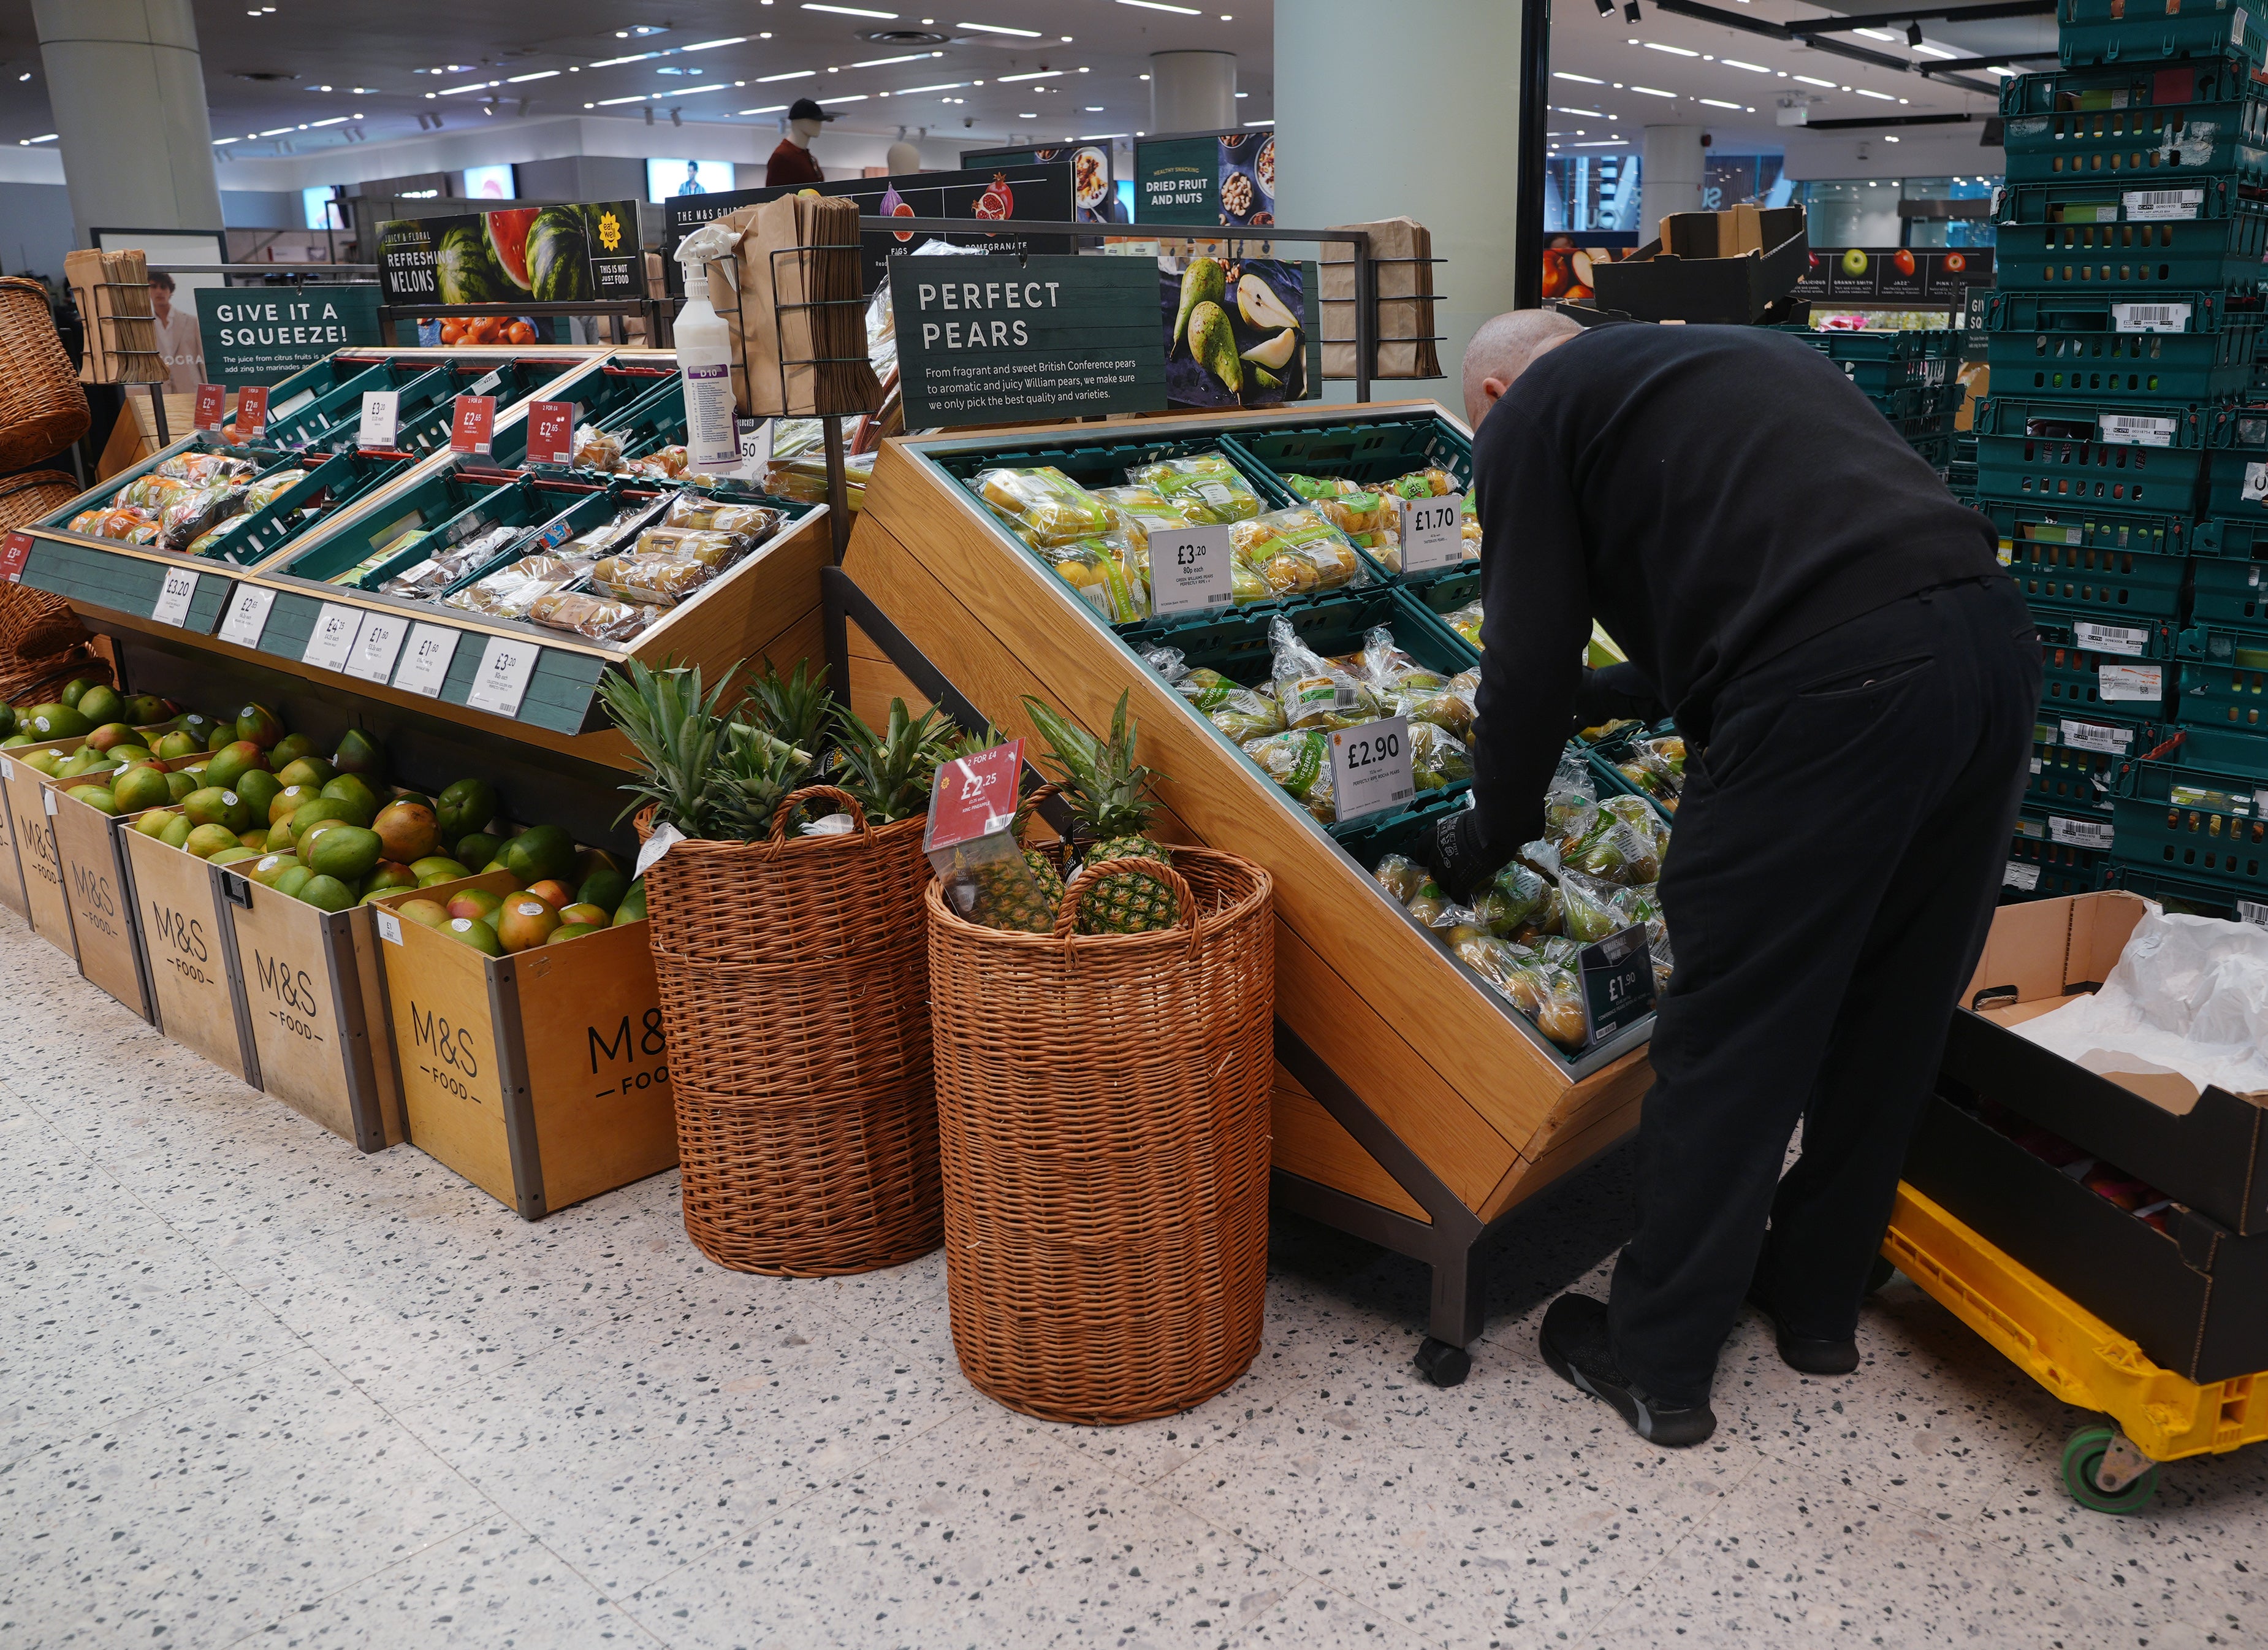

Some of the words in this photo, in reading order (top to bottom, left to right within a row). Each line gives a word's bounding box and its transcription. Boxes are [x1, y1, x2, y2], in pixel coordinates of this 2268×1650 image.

[1153, 167, 1174, 176] HEALTHY
[1146, 180, 1176, 193] DRIED
[1178, 178, 1208, 191] FRUIT
[1151, 194, 1173, 205] AND
[1175, 192, 1203, 204] NUTS
[677, 212, 693, 221] THE
[696, 210, 714, 220] M&S
[603, 223, 613, 231] eat
[604, 227, 617, 239] well
[385, 234, 401, 243] JUICY
[409, 231, 431, 241] FLORAL
[387, 250, 453, 267] REFRESHING
[599, 264, 611, 274] THIS
[612, 264, 617, 273] IS
[618, 264, 628, 273] NOT
[390, 269, 435, 294] MELONS
[614, 274, 630, 285] FOOD
[919, 281, 1060, 311] PERFECT
[217, 304, 278, 322] GIVE
[289, 304, 310, 320] IT
[322, 303, 338, 319] A
[220, 326, 348, 346] SQUEEZE!
[923, 319, 1029, 351] PEARS
[238, 355, 254, 364] juice
[240, 365, 254, 374] zing
[700, 369, 718, 378] D10
[926, 367, 951, 379] From
[953, 365, 991, 380] fragrant
[993, 364, 1010, 375] and
[1012, 364, 1037, 375] sweet
[1039, 361, 1066, 372] British
[1067, 359, 1113, 371] Conference
[1115, 359, 1136, 370] pears
[927, 384, 938, 394] to
[940, 381, 981, 394] aromatic
[983, 379, 1000, 391] and
[1002, 379, 1023, 393] juicy
[1024, 376, 1056, 389] William
[1058, 376, 1083, 389] pears,
[1084, 376, 1095, 386] we
[1096, 373, 1117, 384] make
[1119, 373, 1135, 383] sure
[929, 401, 942, 411] we
[944, 397, 965, 410] only
[967, 395, 986, 409] pick
[987, 394, 1003, 406] the
[1005, 394, 1025, 405] best
[1026, 391, 1056, 405] quality
[1057, 389, 1073, 402] and
[1075, 389, 1111, 400] varieties.
[463, 412, 481, 426] £2.65
[540, 422, 558, 436] £2.65
[1170, 475, 1190, 487] GREEN
[1416, 508, 1453, 531] £1.70
[1178, 544, 1206, 565] £3.20
[167, 579, 189, 597] £3.20
[1103, 556, 1118, 578] GREEN
[1115, 579, 1129, 614] WILLIAMS
[241, 598, 257, 611] £2.65
[370, 628, 389, 643] £1.60
[419, 640, 439, 656] £1.60
[495, 653, 516, 671] £3.20
[973, 755, 987, 765] FOR
[988, 751, 997, 760] £4
[1349, 734, 1399, 769] £2.90
[961, 773, 997, 800] £2.25
[1353, 777, 1370, 786] PERFECTLY
[971, 800, 991, 811] PINEAPPLE
[72, 861, 114, 917] M&S
[153, 901, 207, 963] M&S
[255, 949, 316, 1018] M&S
[1609, 972, 1635, 1002] £1.90
[411, 1001, 478, 1079] M&S
[587, 1007, 666, 1074] M&
